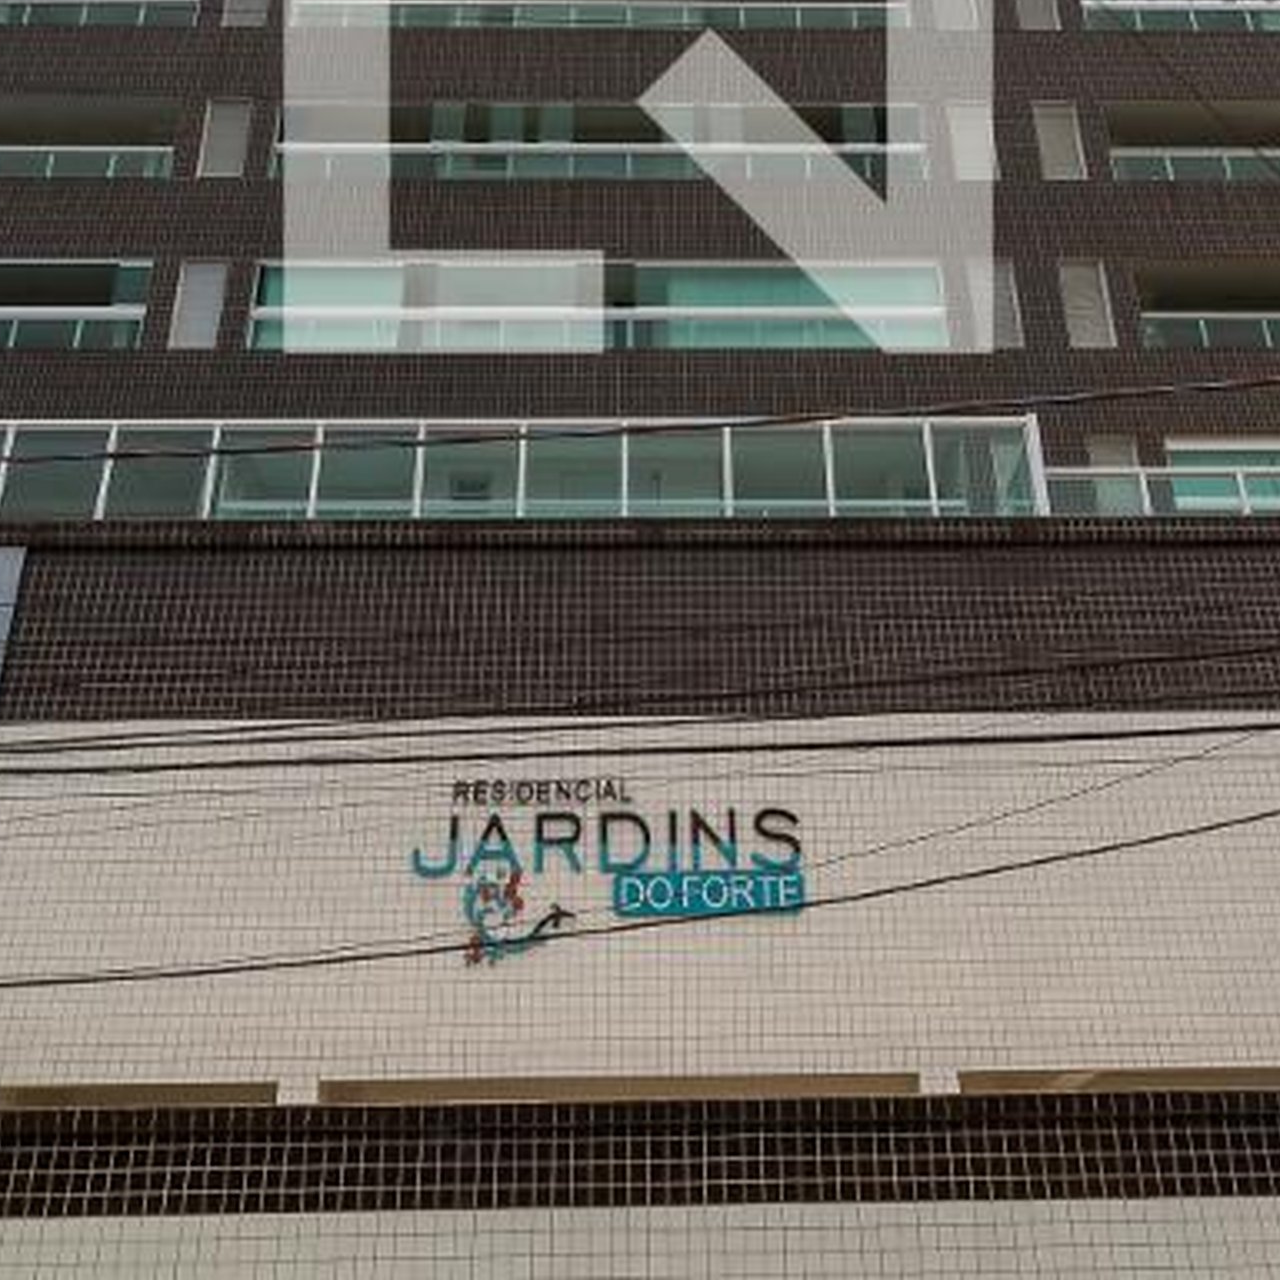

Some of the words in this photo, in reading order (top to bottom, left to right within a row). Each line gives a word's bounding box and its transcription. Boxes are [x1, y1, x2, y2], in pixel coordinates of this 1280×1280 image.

[452, 779, 631, 805] RESIDENCIAL
[411, 807, 803, 878] JARDINS
[619, 876, 674, 910] DO
[679, 874, 801, 909] FORTE
